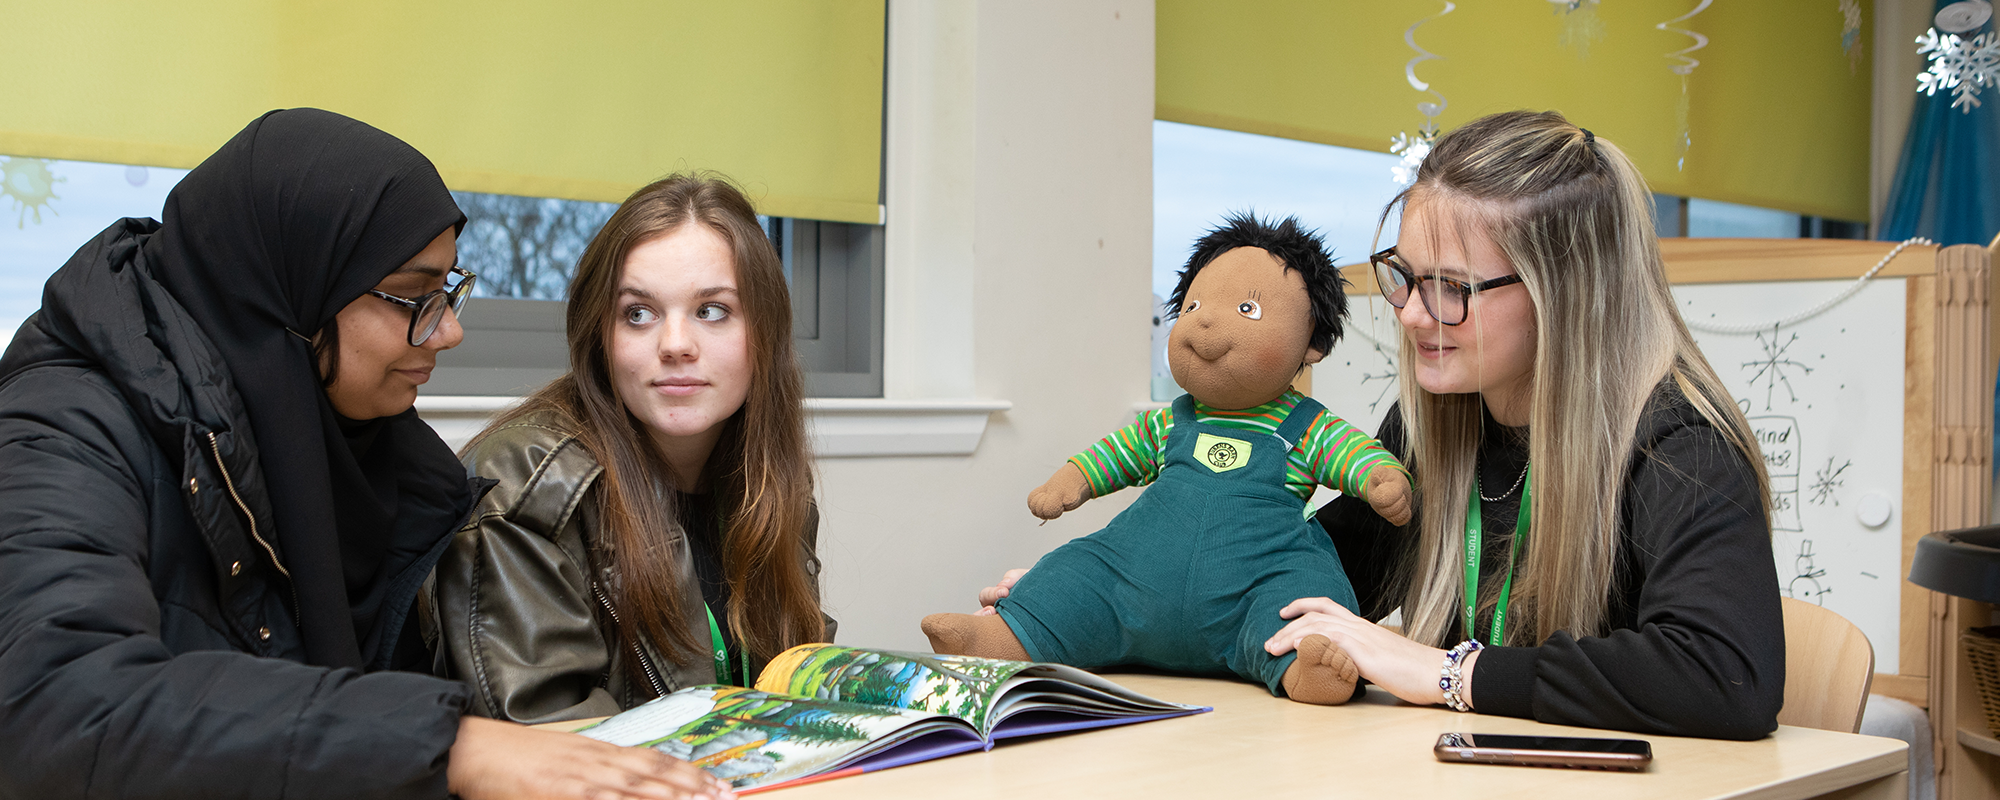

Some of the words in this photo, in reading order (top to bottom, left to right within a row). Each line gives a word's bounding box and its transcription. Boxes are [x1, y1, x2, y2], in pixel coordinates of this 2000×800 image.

[1763, 449, 1791, 468] nts?
[1775, 493, 1791, 511] ds
[1467, 529, 1477, 567] STUDENT
